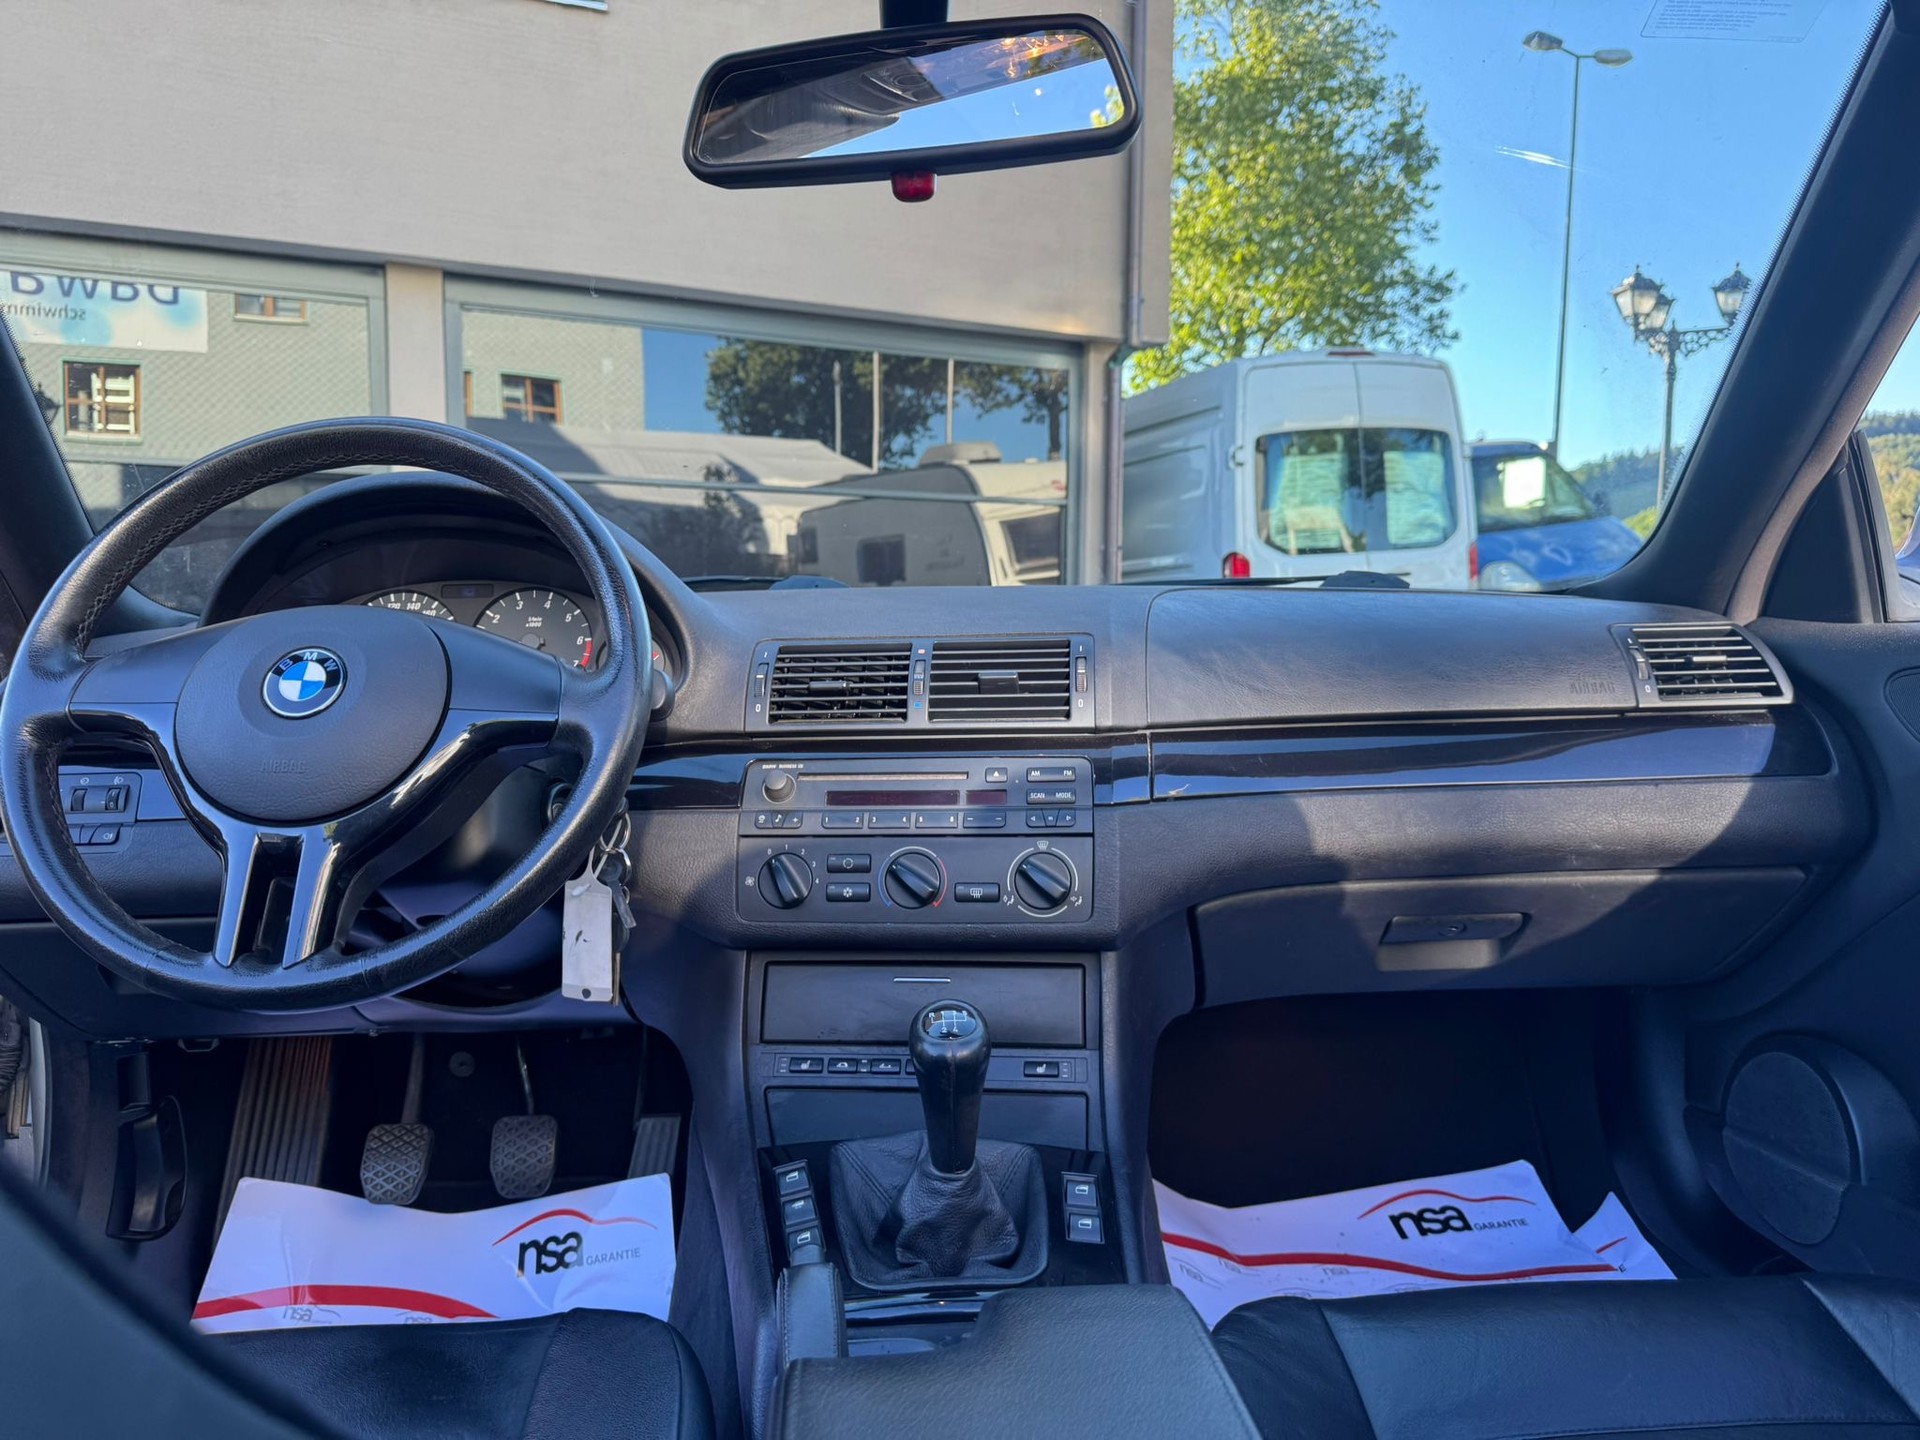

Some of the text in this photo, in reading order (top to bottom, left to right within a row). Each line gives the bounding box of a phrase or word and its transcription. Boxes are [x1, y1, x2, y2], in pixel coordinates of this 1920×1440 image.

[407, 603, 421, 611] 140
[516, 601, 523, 610] 3
[544, 601, 551, 609] 4
[492, 614, 500, 624] 2
[565, 613, 572, 622] 5
[577, 636, 584, 645] 6
[279, 651, 338, 672] BMW
[1388, 1205, 1528, 1240] nsa GARANTIE
[517, 1231, 641, 1278] nsa GARANTIE
[283, 1306, 312, 1322] nsa
